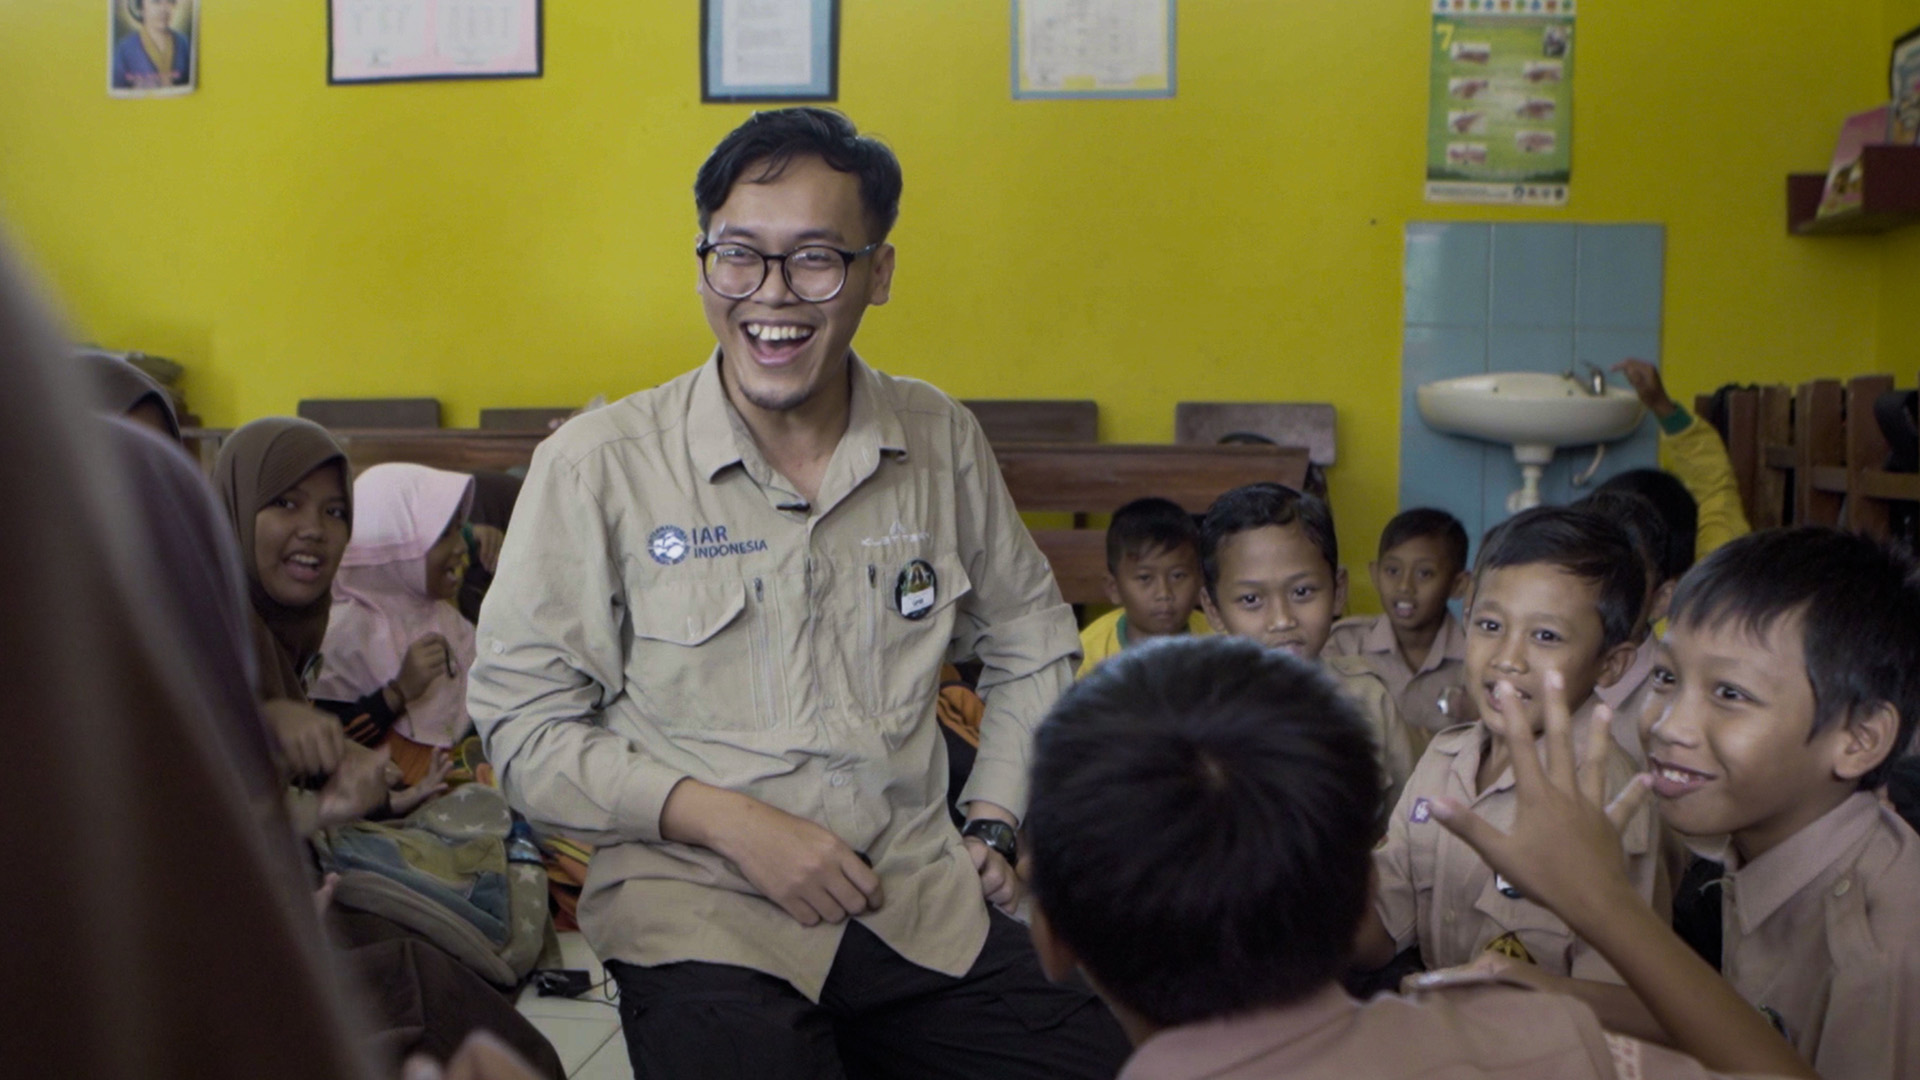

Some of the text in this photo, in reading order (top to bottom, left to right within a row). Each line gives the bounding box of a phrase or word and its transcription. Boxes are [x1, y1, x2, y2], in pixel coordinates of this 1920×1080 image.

[1436, 23, 1454, 49] 7
[691, 525, 728, 545] IAR
[694, 539, 768, 559] INDONESIA
